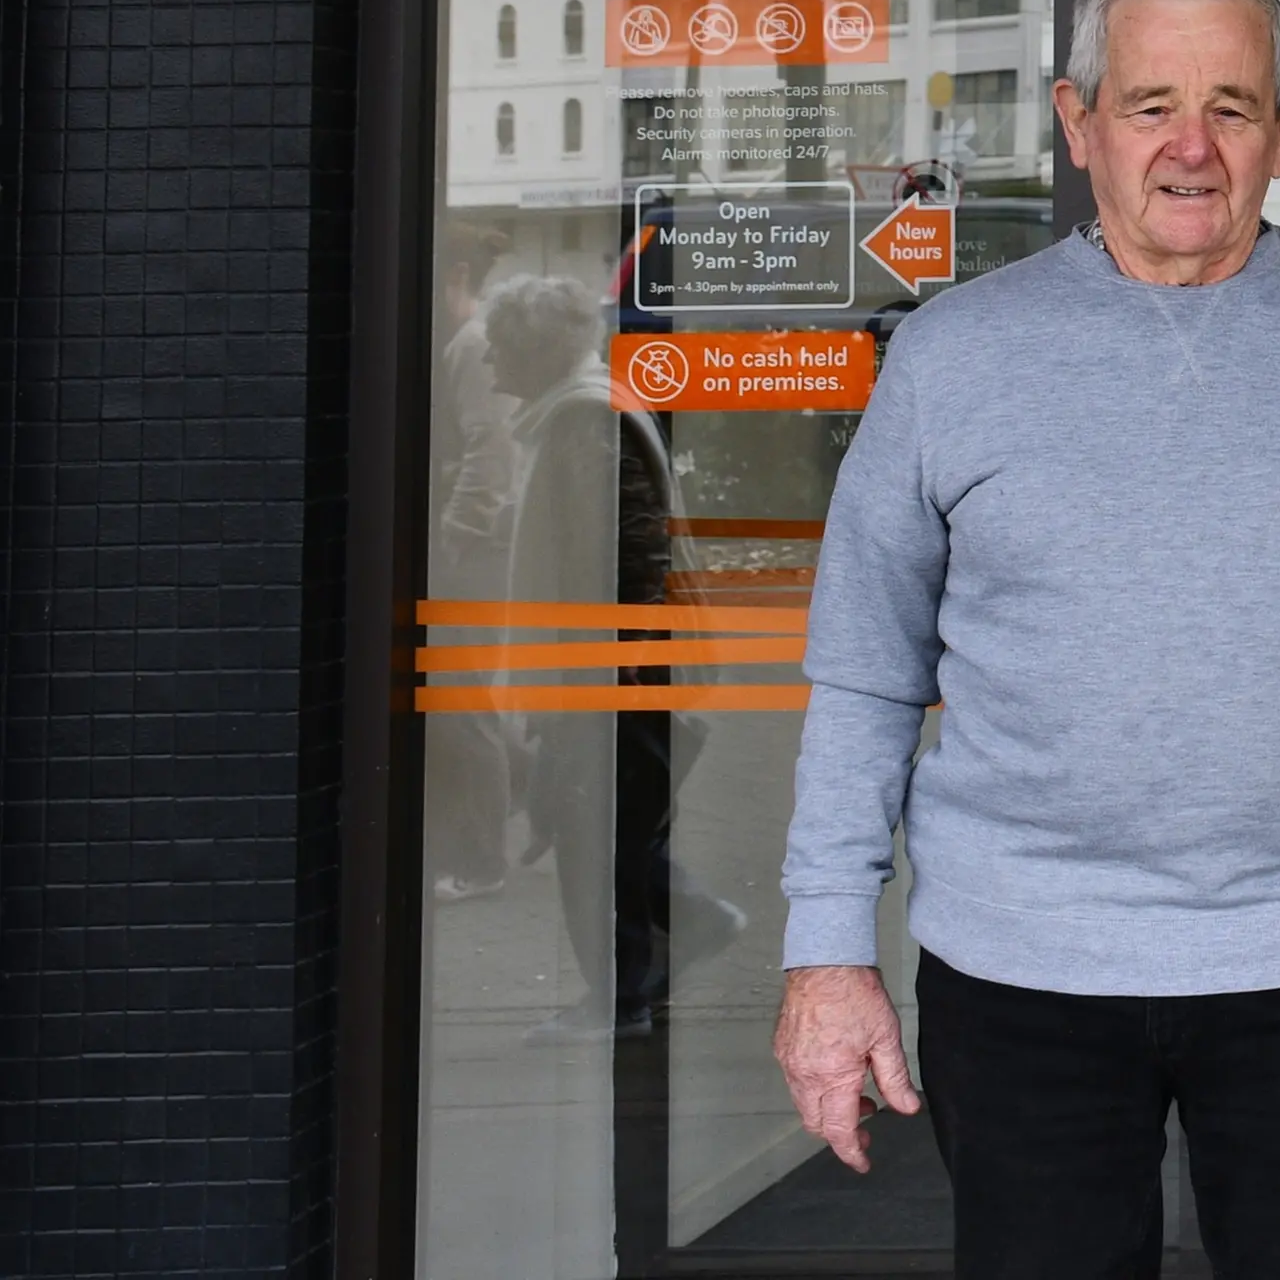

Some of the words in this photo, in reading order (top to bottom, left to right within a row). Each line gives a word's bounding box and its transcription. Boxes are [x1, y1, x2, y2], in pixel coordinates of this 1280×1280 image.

[606, 87, 653, 99] Please
[658, 88, 713, 98] remove
[785, 86, 818, 99] caps
[823, 83, 849, 96] and
[855, 83, 889, 95] hats.
[654, 106, 675, 119] Do
[679, 107, 703, 119] not
[707, 106, 739, 118] take
[742, 104, 840, 122] photographs.
[636, 127, 695, 143] Security
[700, 128, 762, 140] cameras
[766, 126, 779, 138] in
[783, 125, 857, 141] operation.
[662, 147, 712, 161] Alarms
[717, 146, 792, 160] monitored
[719, 202, 770, 223] Open
[659, 227, 738, 248] Monday
[744, 228, 764, 244] to
[770, 226, 831, 248] Friday
[896, 222, 936, 240] New
[890, 242, 942, 260] hours
[691, 251, 736, 269] 9am
[753, 250, 798, 272] 3pm
[650, 281, 675, 294] 3pm
[684, 281, 727, 294] 4.30pm
[730, 280, 743, 294] by
[745, 280, 814, 294] appointment
[816, 280, 839, 294] only
[703, 347, 735, 368] No
[741, 347, 793, 368] cash
[800, 346, 848, 367] held
[703, 374, 730, 391] on
[738, 372, 844, 396] premises.
